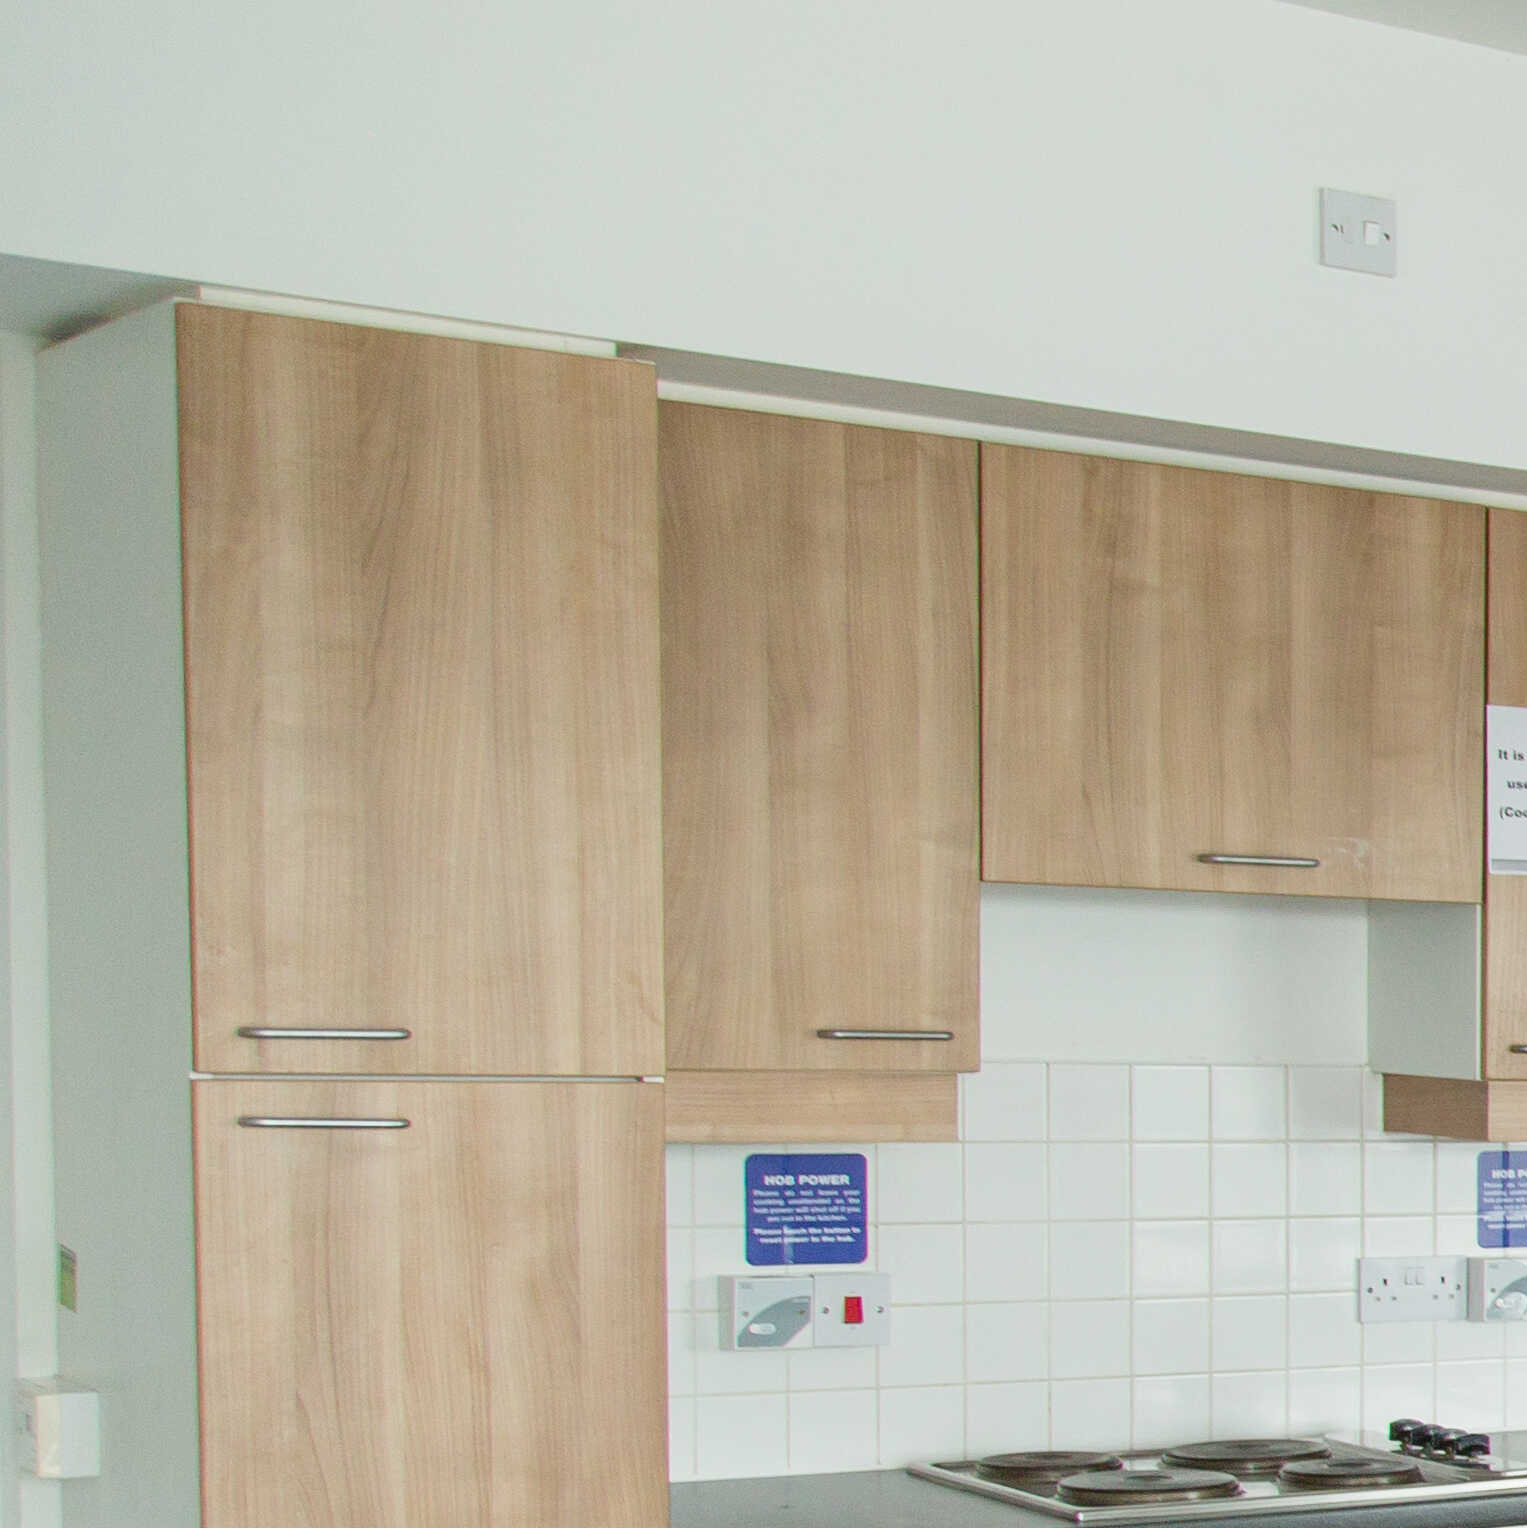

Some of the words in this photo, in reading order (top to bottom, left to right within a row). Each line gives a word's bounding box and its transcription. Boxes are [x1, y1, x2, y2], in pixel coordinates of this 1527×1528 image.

[1497, 748, 1508, 761] It
[1512, 749, 1524, 762] is
[763, 1174, 796, 1186] HOB
[798, 1174, 851, 1186] POWER
